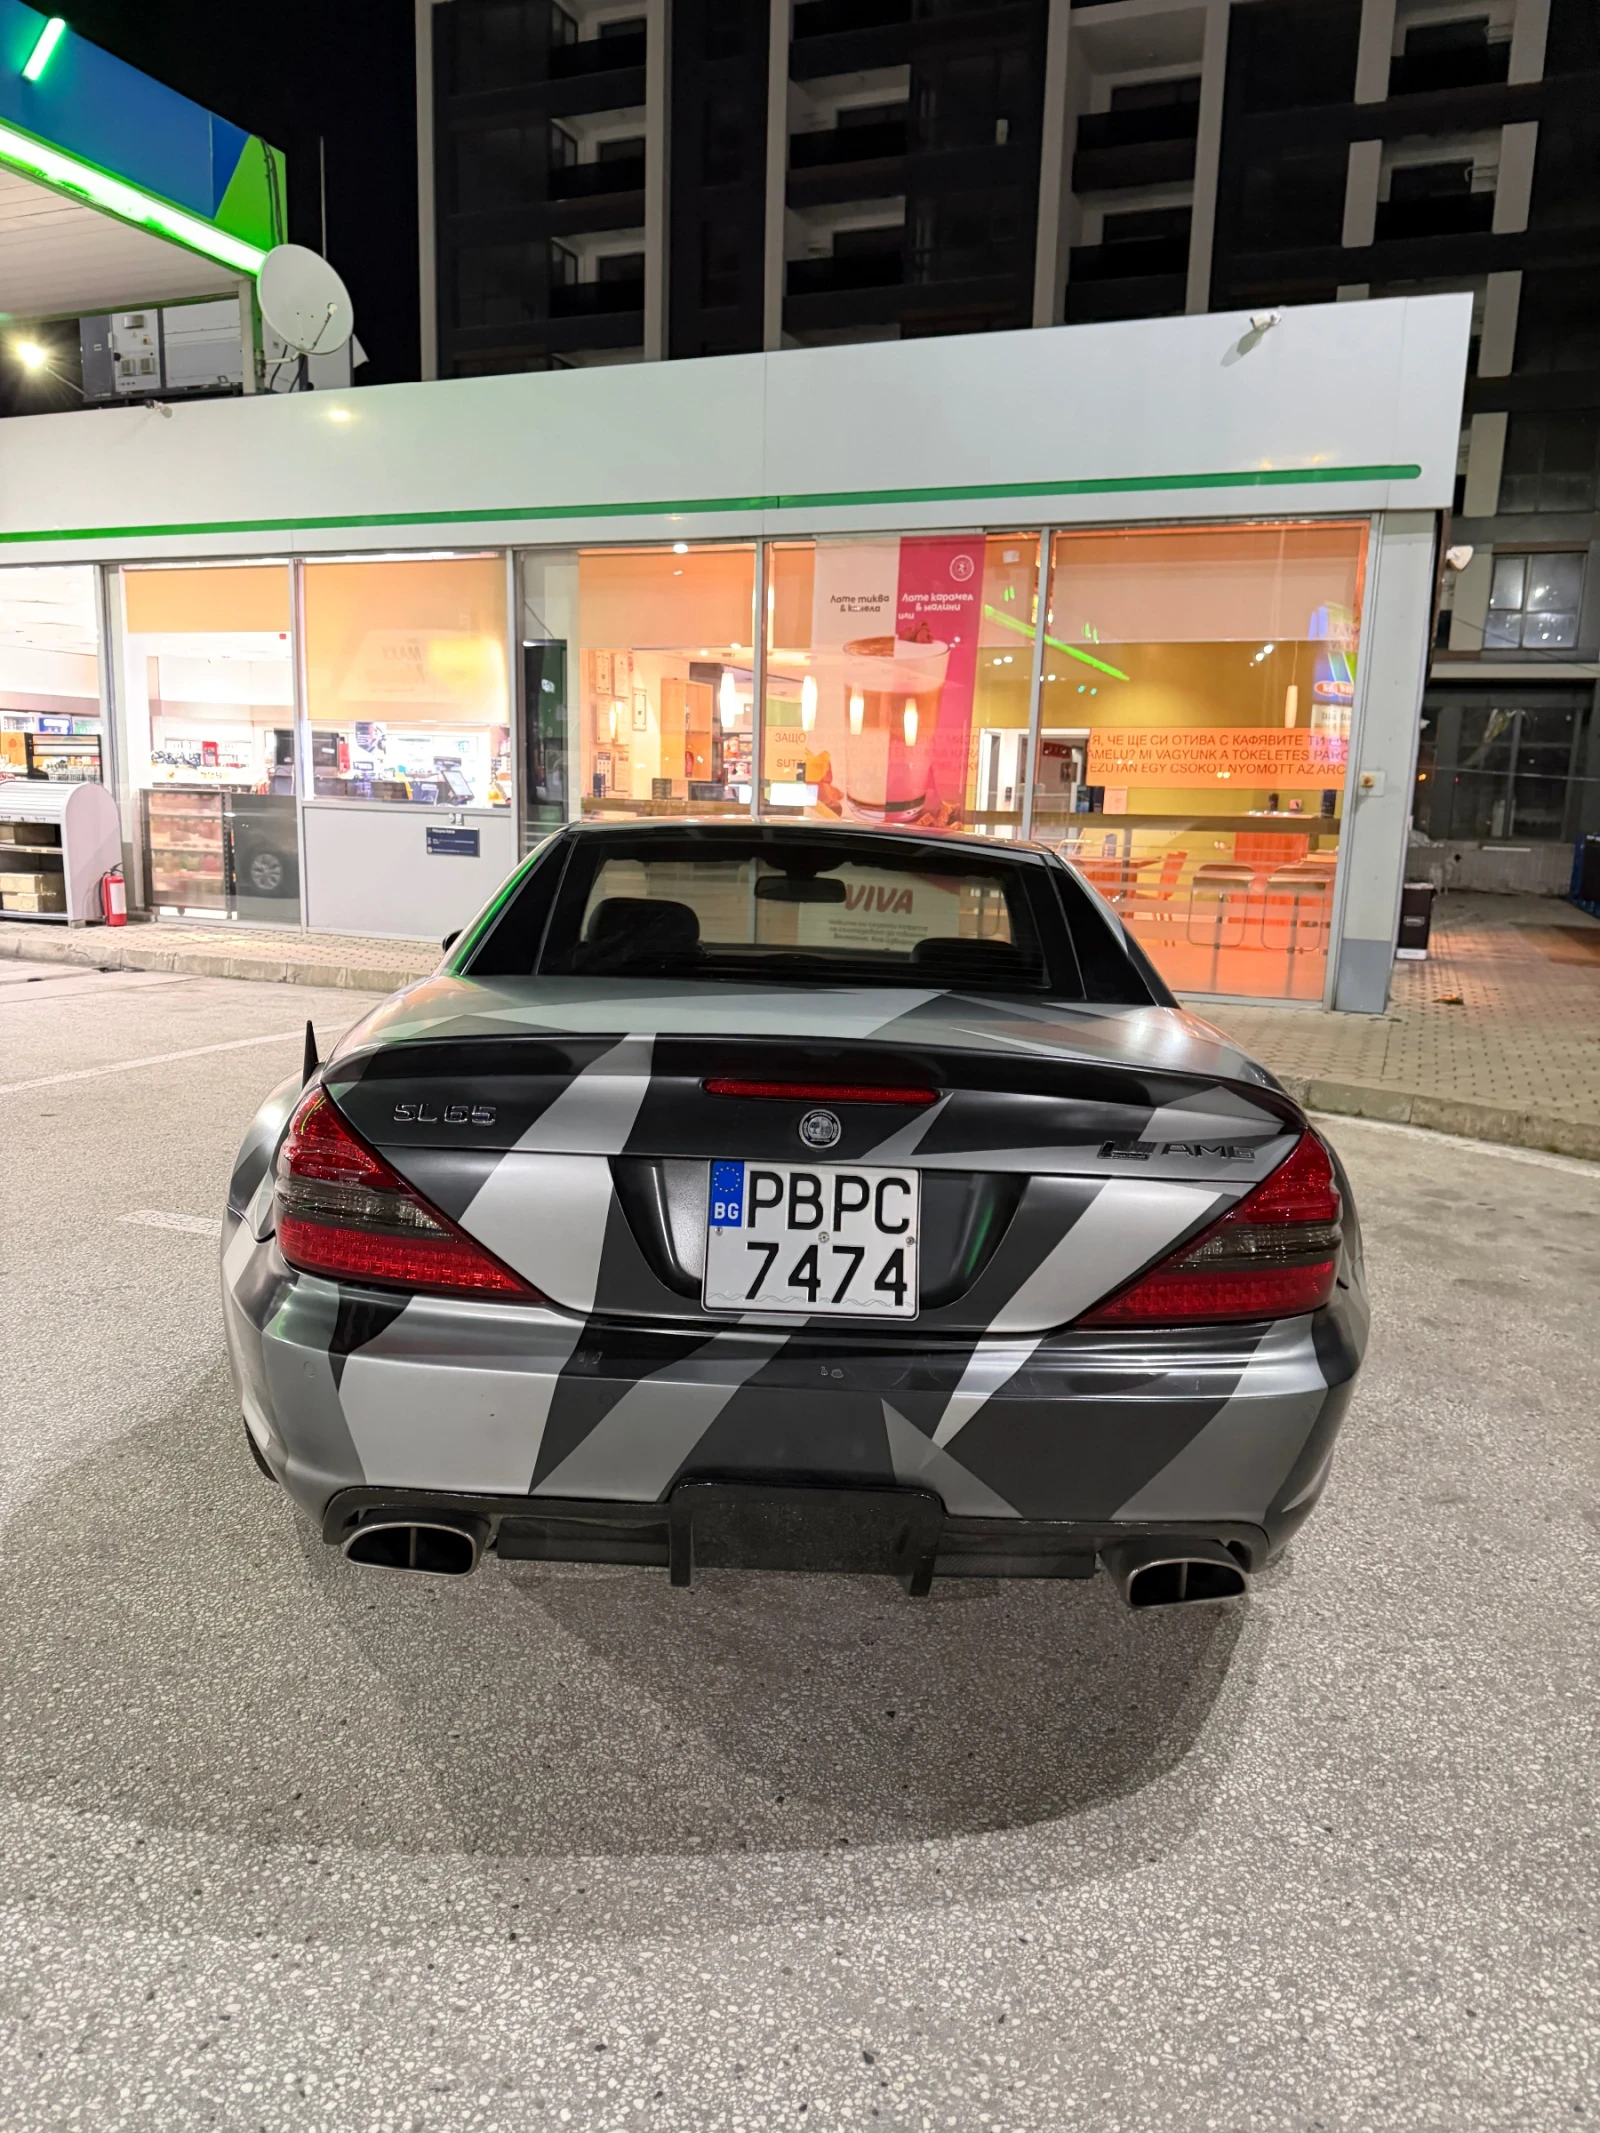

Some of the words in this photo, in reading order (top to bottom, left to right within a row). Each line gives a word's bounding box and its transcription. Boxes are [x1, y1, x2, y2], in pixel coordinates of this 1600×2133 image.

[775, 732, 807, 745] ЗАЩО
[1107, 734, 1124, 746] ЧЕ
[1127, 734, 1148, 748] ЩЕ
[1149, 735, 1169, 746] СИ
[1171, 735, 1216, 746] ОТИВА
[1232, 735, 1304, 746] КАФЯВИТЕ
[1139, 749, 1152, 760] MI
[1155, 749, 1218, 760] VAGYUNK
[1219, 749, 1229, 760] A
[1141, 763, 1167, 774] EGY
[1228, 764, 1296, 774] NYOMOTT
[1296, 764, 1315, 774] AZ
[845, 884, 914, 915] VIVA
[1160, 1143, 1256, 1163] AMG
[713, 1202, 739, 1220] BG
[747, 1170, 911, 1235] PBPC
[744, 1241, 908, 1307] 7474
